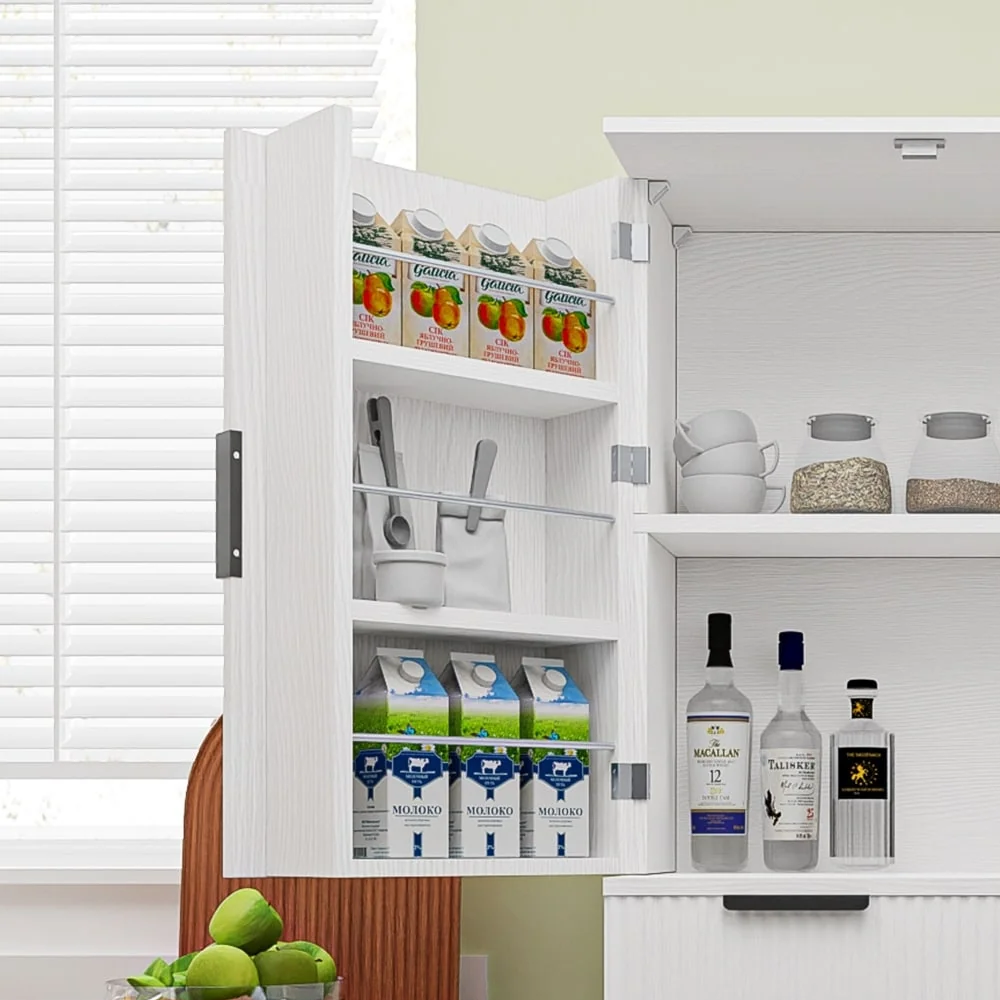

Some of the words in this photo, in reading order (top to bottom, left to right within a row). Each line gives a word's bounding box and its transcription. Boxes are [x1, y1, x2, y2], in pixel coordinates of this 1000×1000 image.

[353, 252, 391, 267] alicia
[693, 748, 740, 758] MACALLAN
[709, 769, 722, 783] 12
[392, 805, 442, 815] МОЛОКО
[466, 806, 514, 816] МОЛОКО
[538, 807, 583, 817] МОЛОКО
